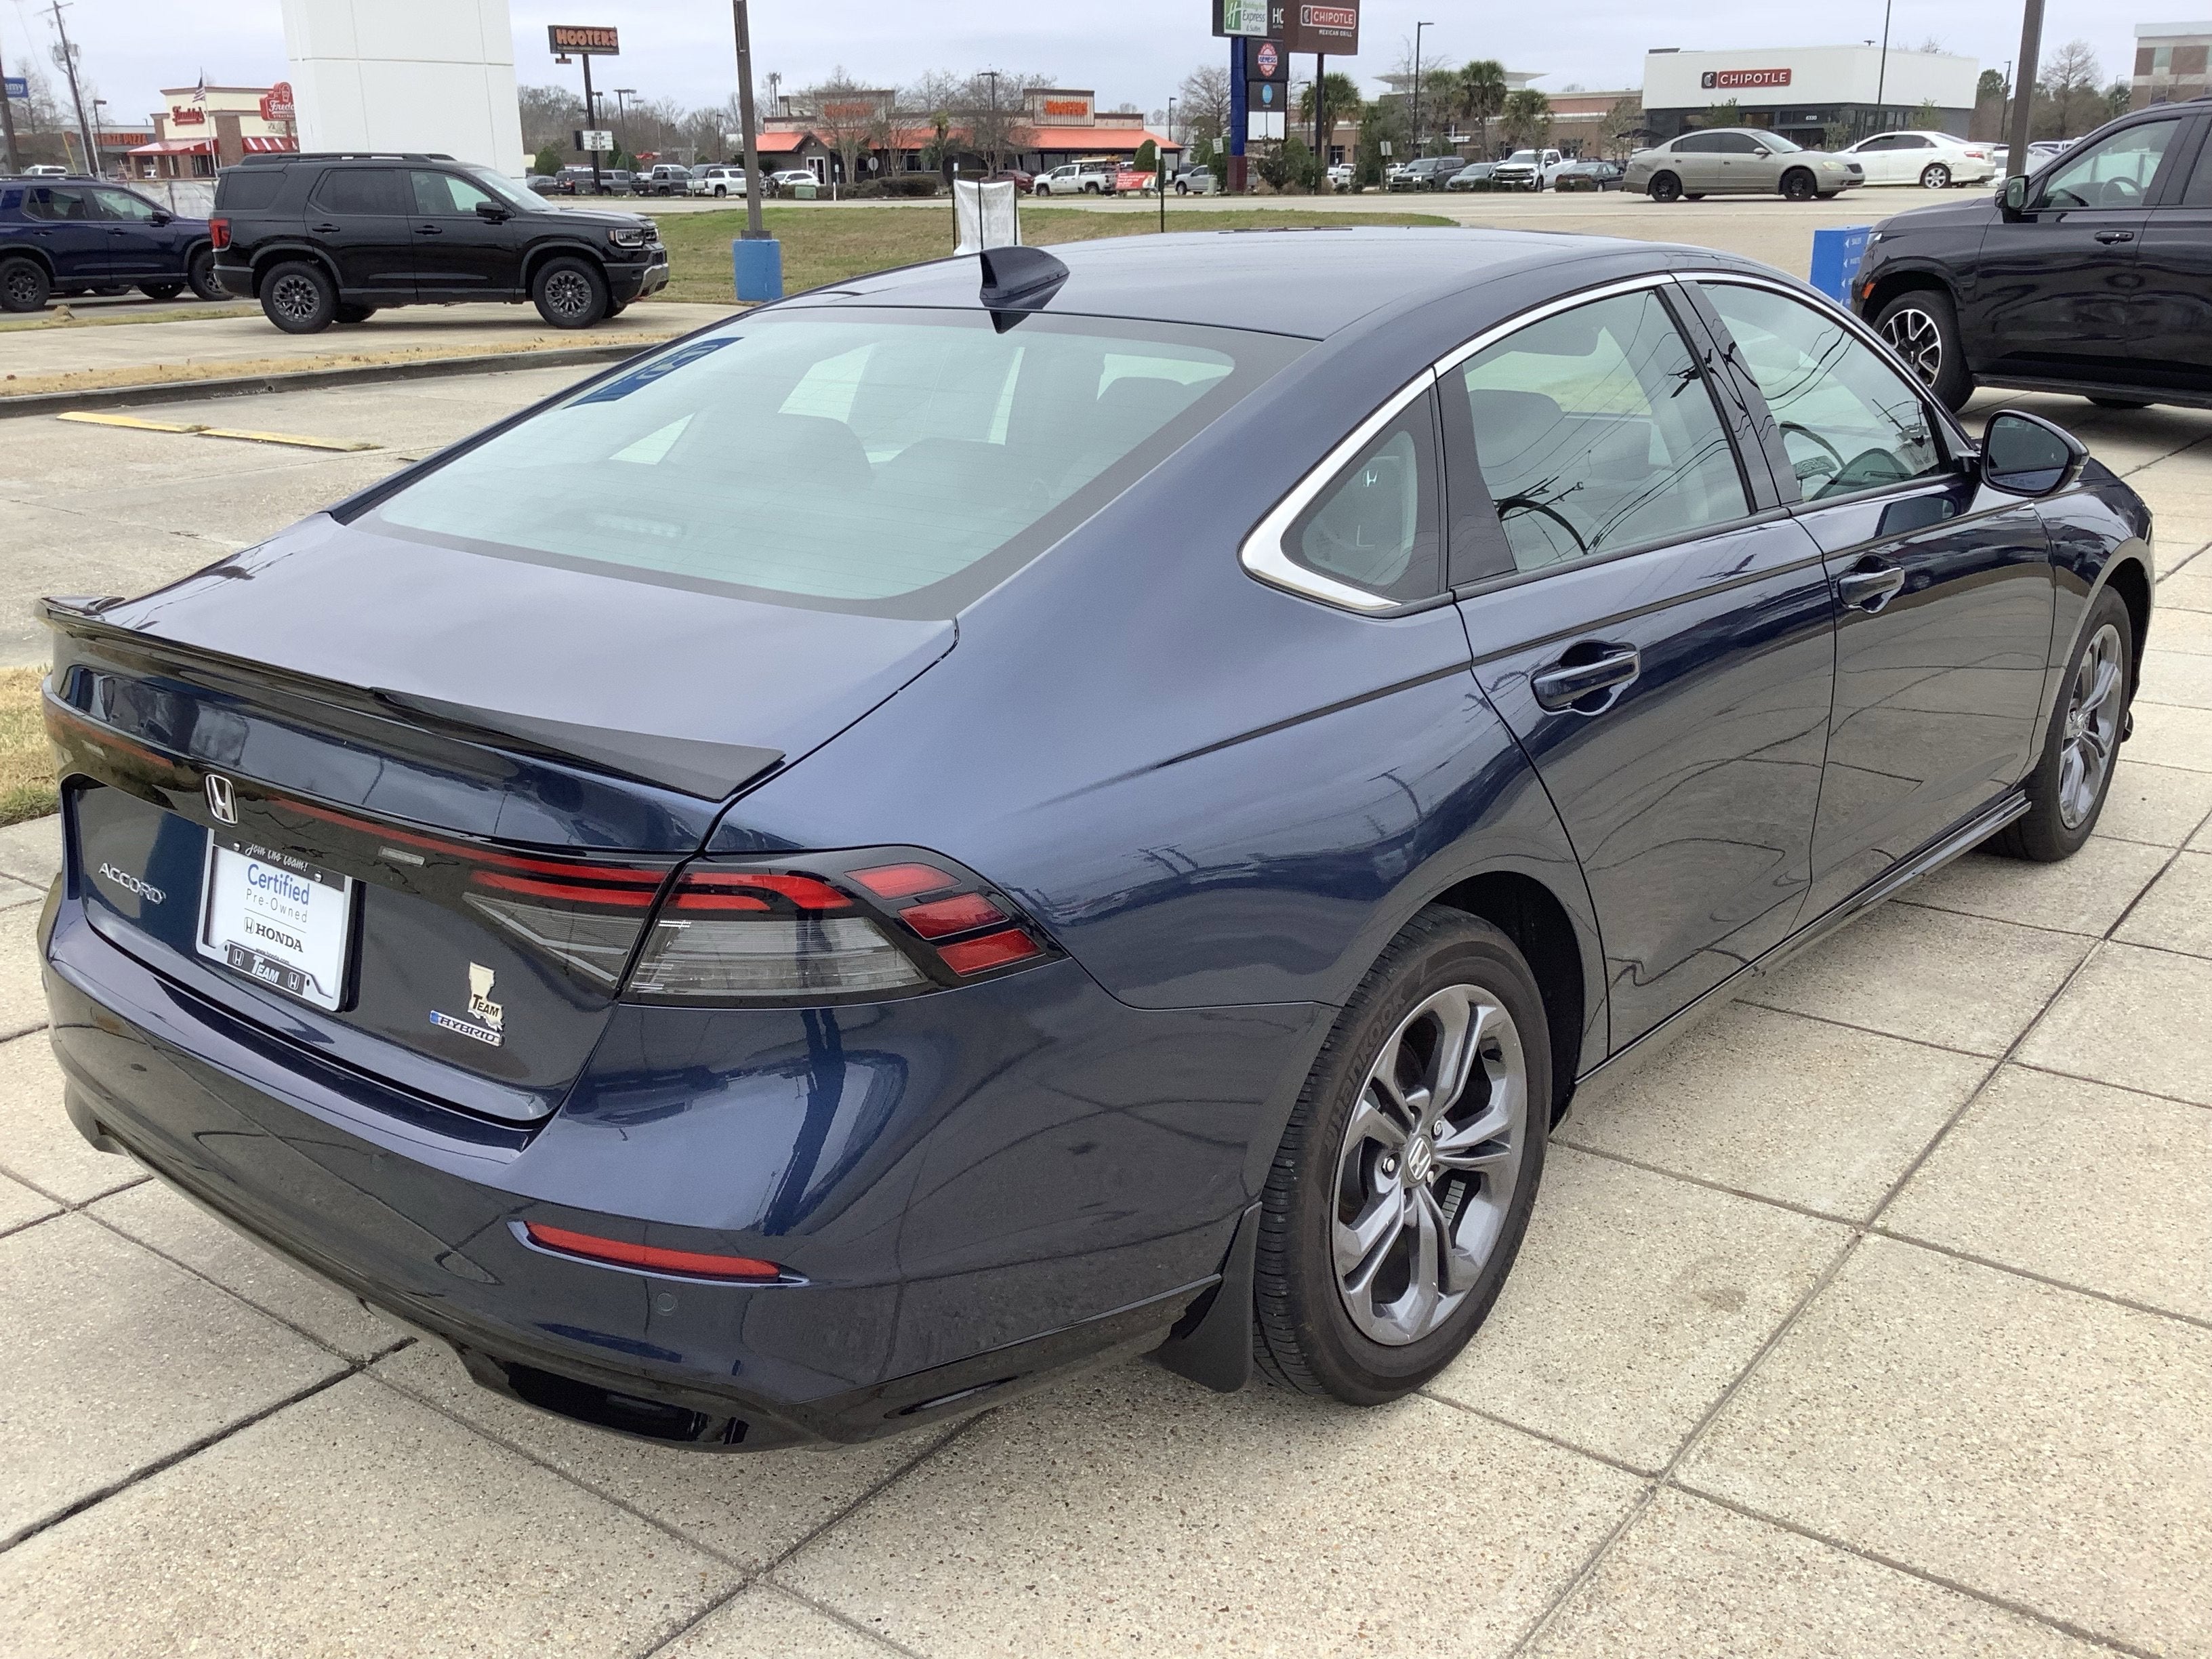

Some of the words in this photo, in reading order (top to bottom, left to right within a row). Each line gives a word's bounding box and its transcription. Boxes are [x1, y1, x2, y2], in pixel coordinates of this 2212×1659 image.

[1242, 9, 1265, 24] Express
[1313, 11, 1354, 24] CHIPOTLE
[556, 28, 617, 47] HOOTERS
[1720, 72, 1787, 85] CHIPOTLE
[98, 863, 166, 905] ACCORD
[247, 863, 310, 905] Certified
[246, 888, 308, 923] Pre-Owned
[255, 923, 304, 953] HONDA
[441, 1017, 499, 1042] HYBRID
